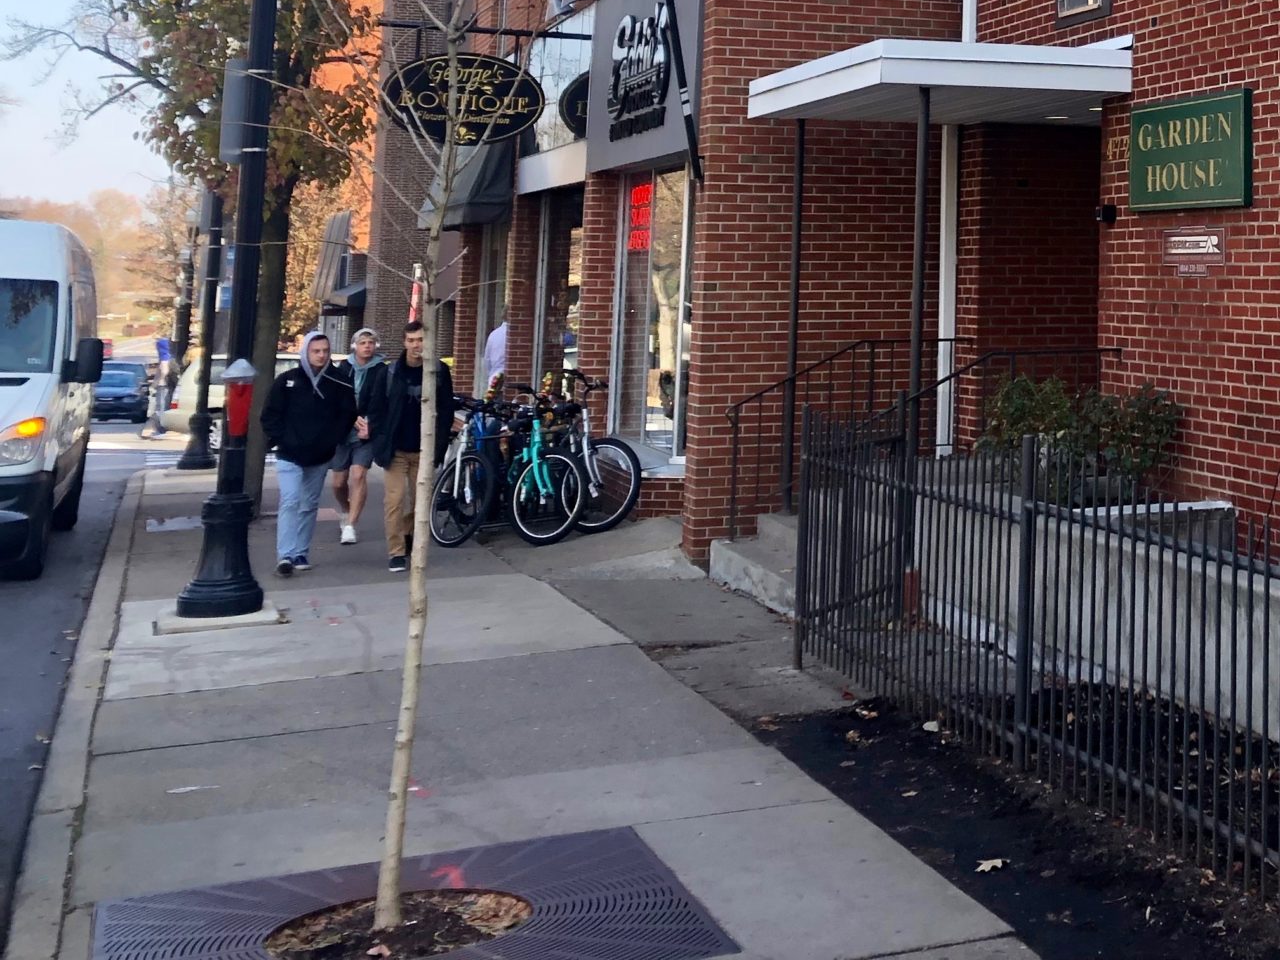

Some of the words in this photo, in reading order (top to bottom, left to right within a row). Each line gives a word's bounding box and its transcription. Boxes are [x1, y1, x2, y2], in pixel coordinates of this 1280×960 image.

[429, 61, 503, 90] George's
[1138, 112, 1232, 152] GARDEN
[1146, 158, 1222, 193] HOUSE
